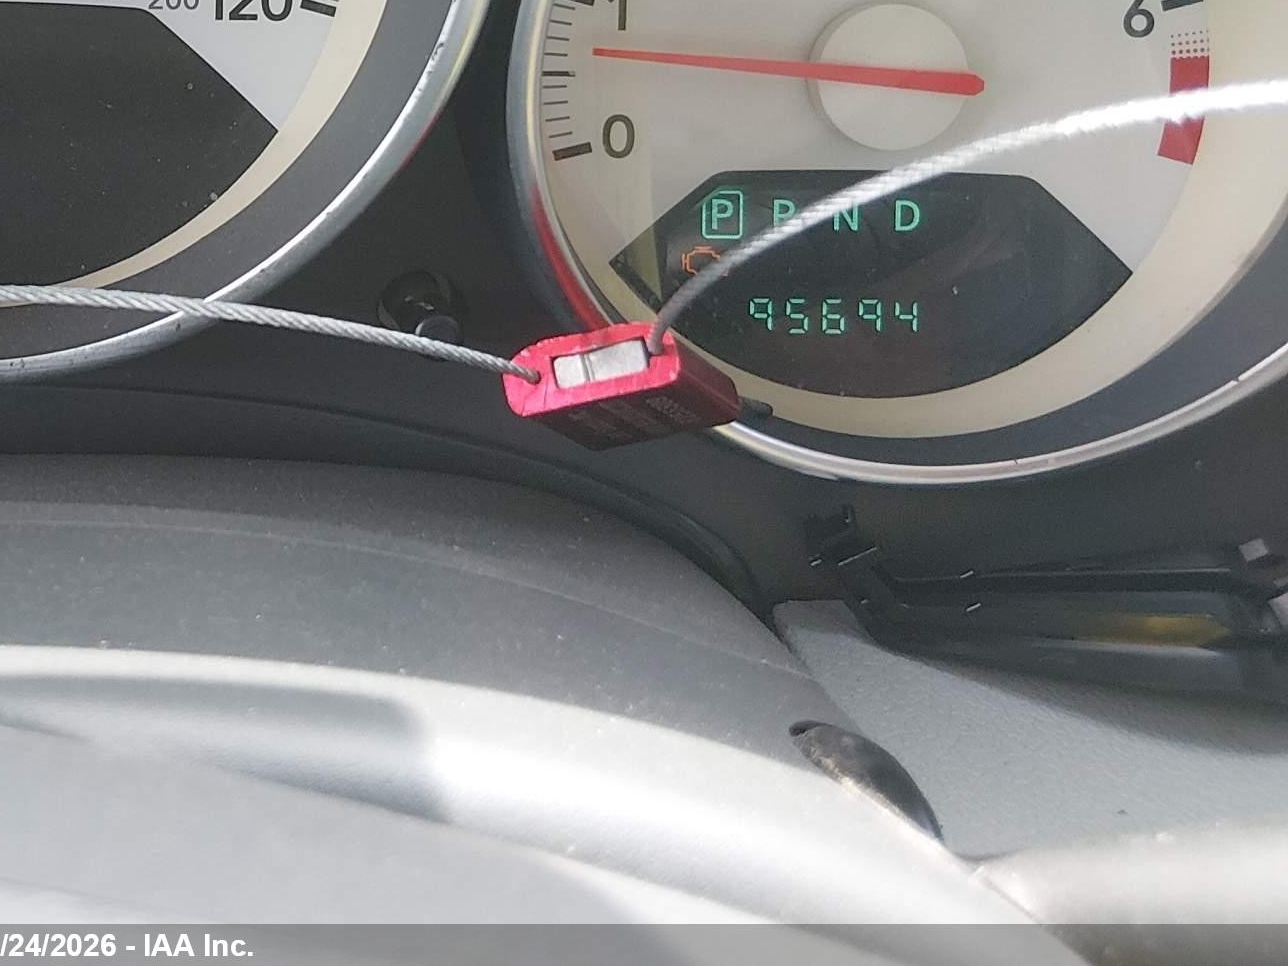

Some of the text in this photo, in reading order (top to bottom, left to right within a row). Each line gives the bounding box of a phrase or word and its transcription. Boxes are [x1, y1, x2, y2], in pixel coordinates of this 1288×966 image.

[602, 113, 635, 159] 0
[711, 198, 734, 231] P
[894, 199, 921, 232] D
[751, 298, 919, 334] 95694
